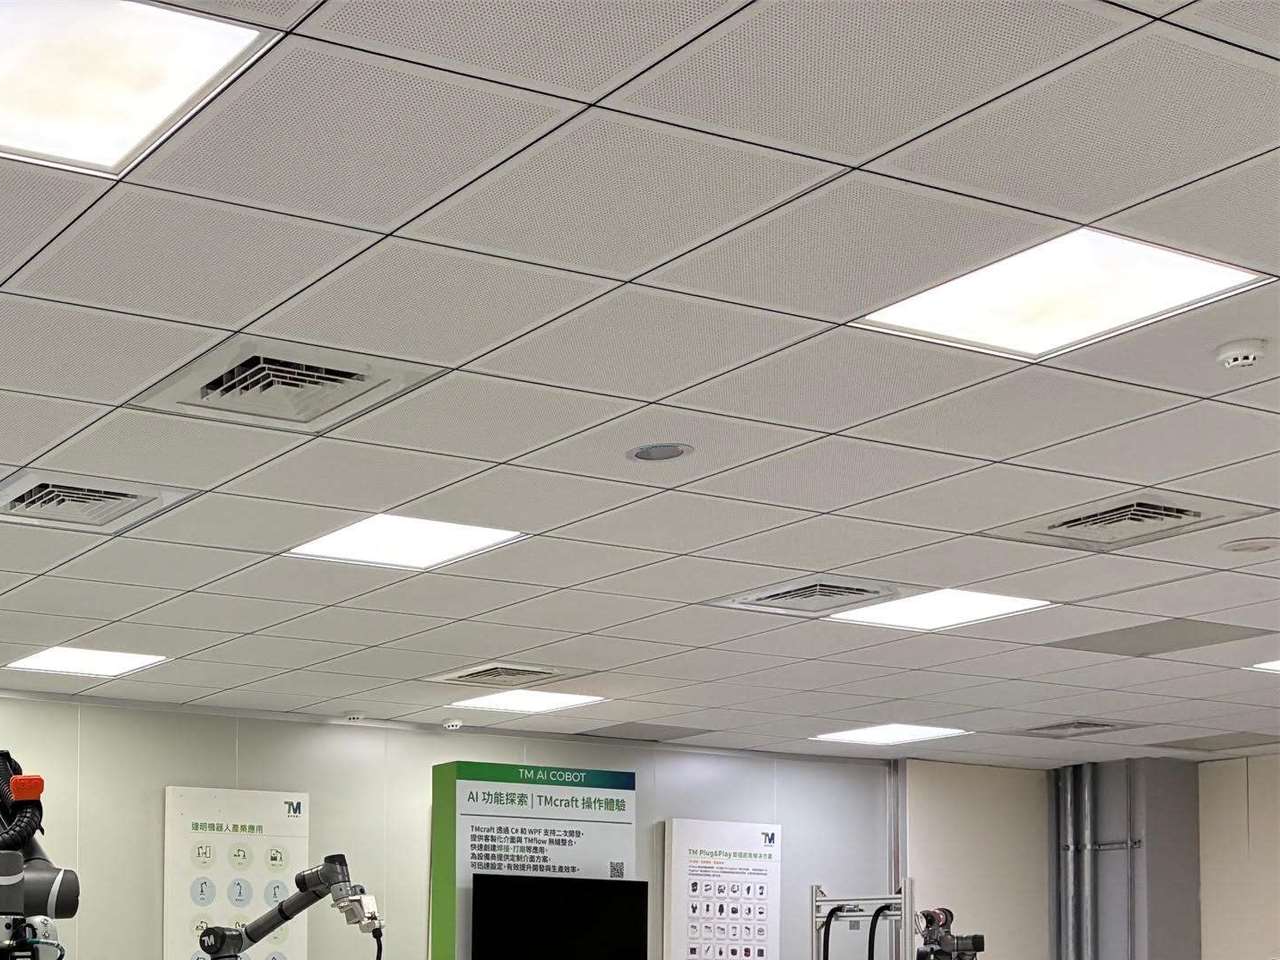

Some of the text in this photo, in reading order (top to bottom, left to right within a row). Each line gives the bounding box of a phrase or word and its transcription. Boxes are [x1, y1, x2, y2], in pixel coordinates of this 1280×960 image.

[518, 769, 587, 783] TM AI COBOT
[467, 791, 626, 812] AI 功能探索 TMcraft 操作體驗
